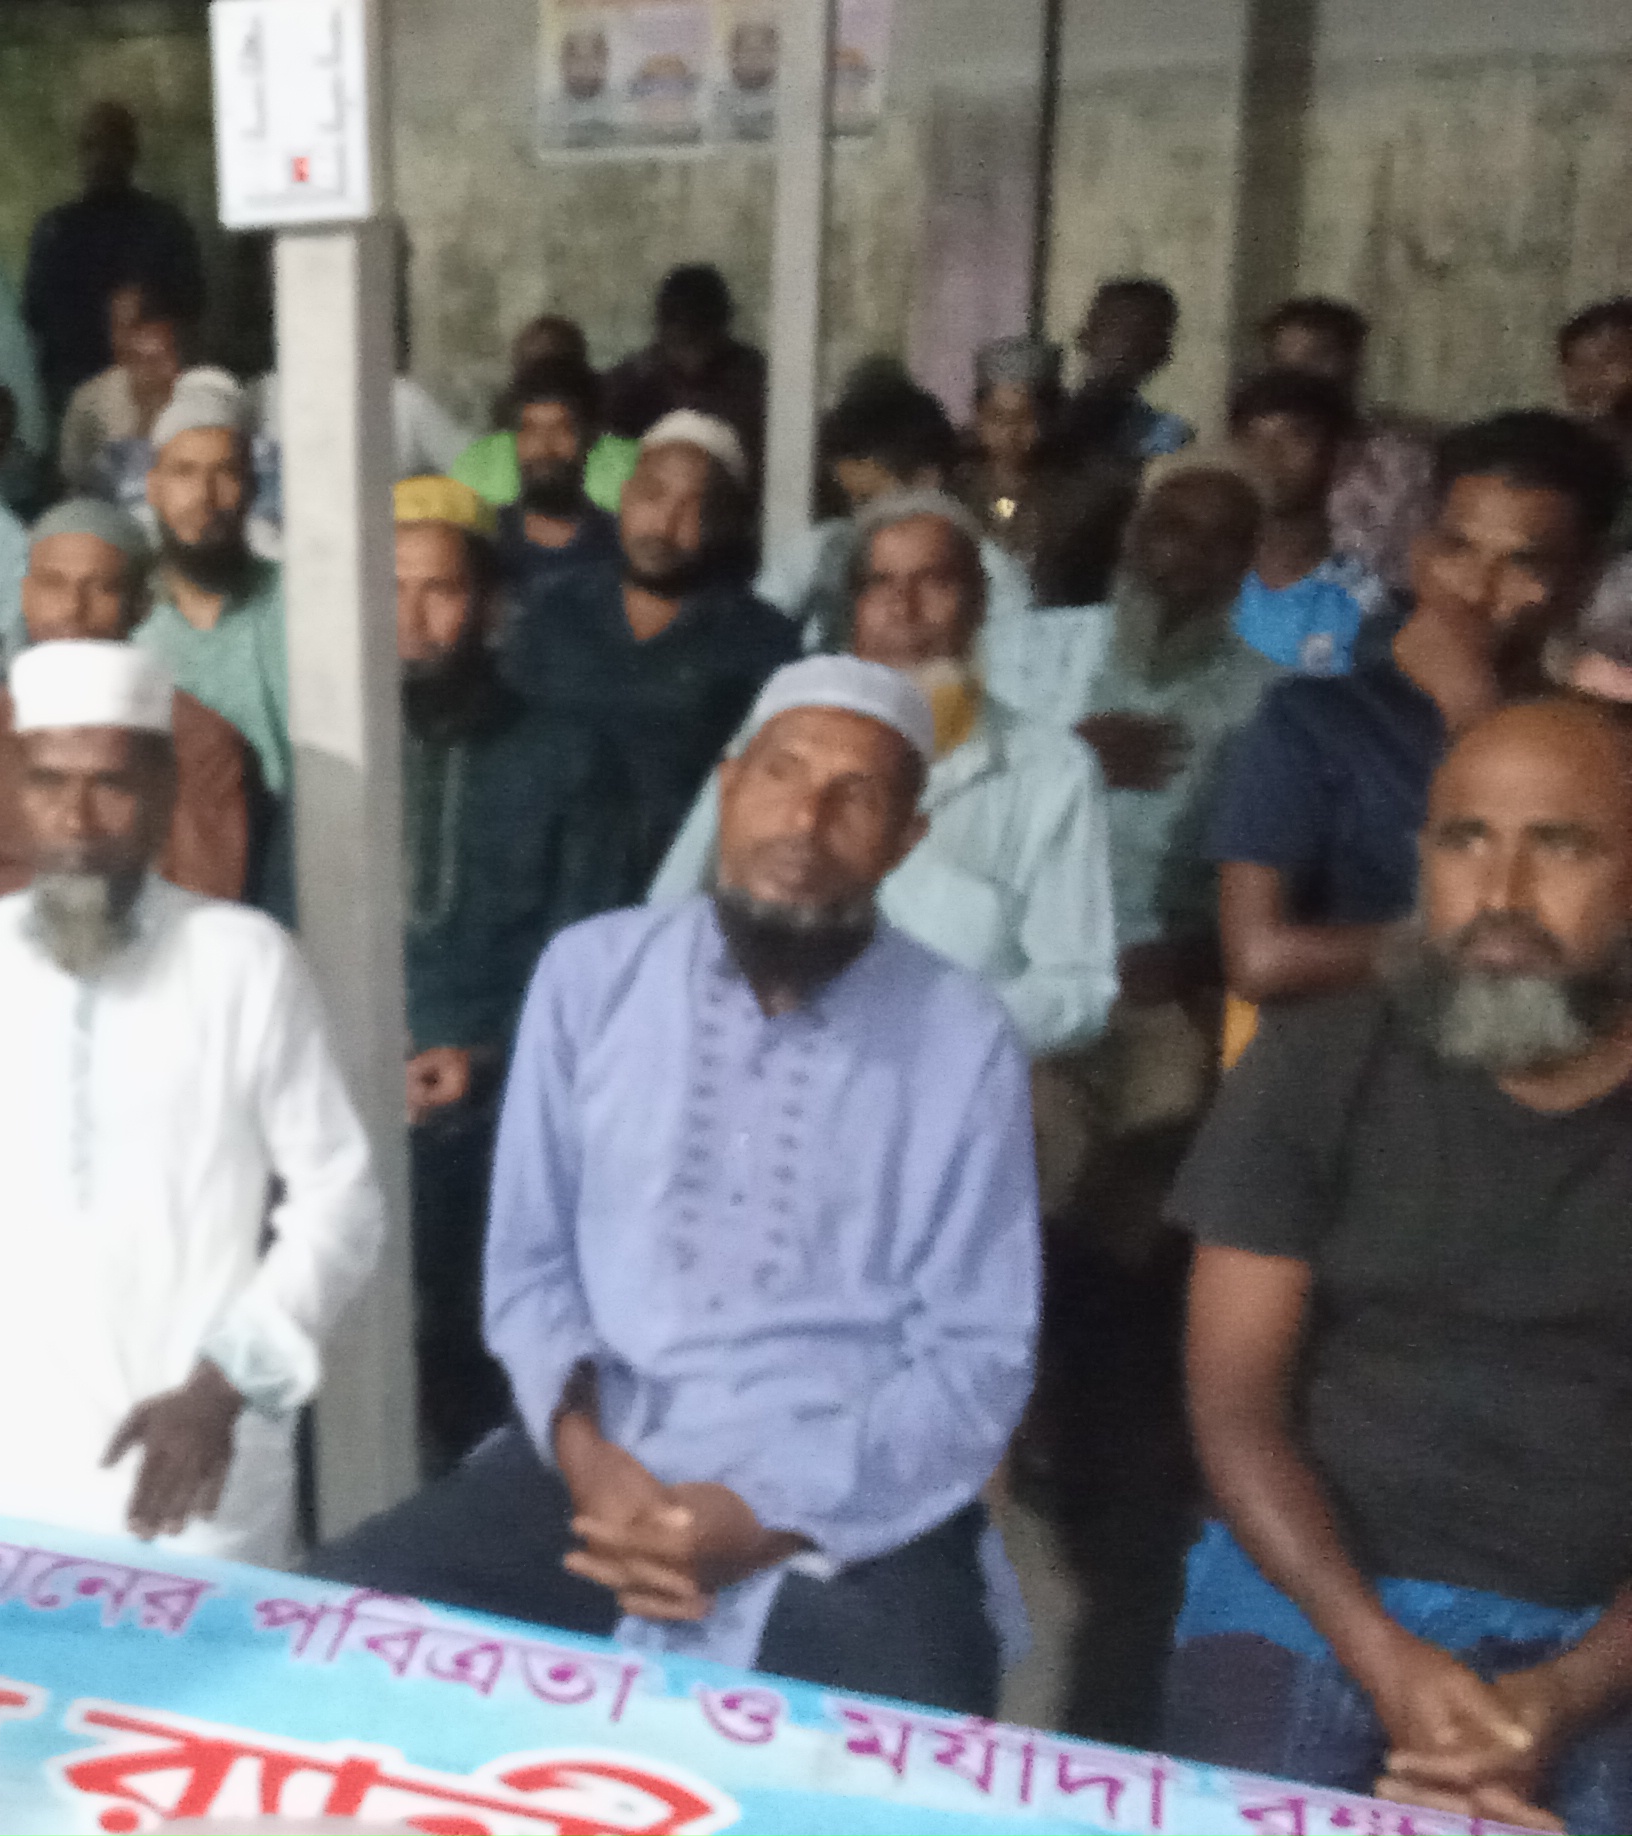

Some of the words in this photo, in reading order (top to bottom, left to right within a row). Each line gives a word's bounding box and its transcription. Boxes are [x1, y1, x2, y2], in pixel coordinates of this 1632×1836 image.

[253, 1588, 652, 1724] পবিত্রতা
[694, 1684, 782, 1744] ও
[828, 1695, 1170, 1829] মর্যাদা
